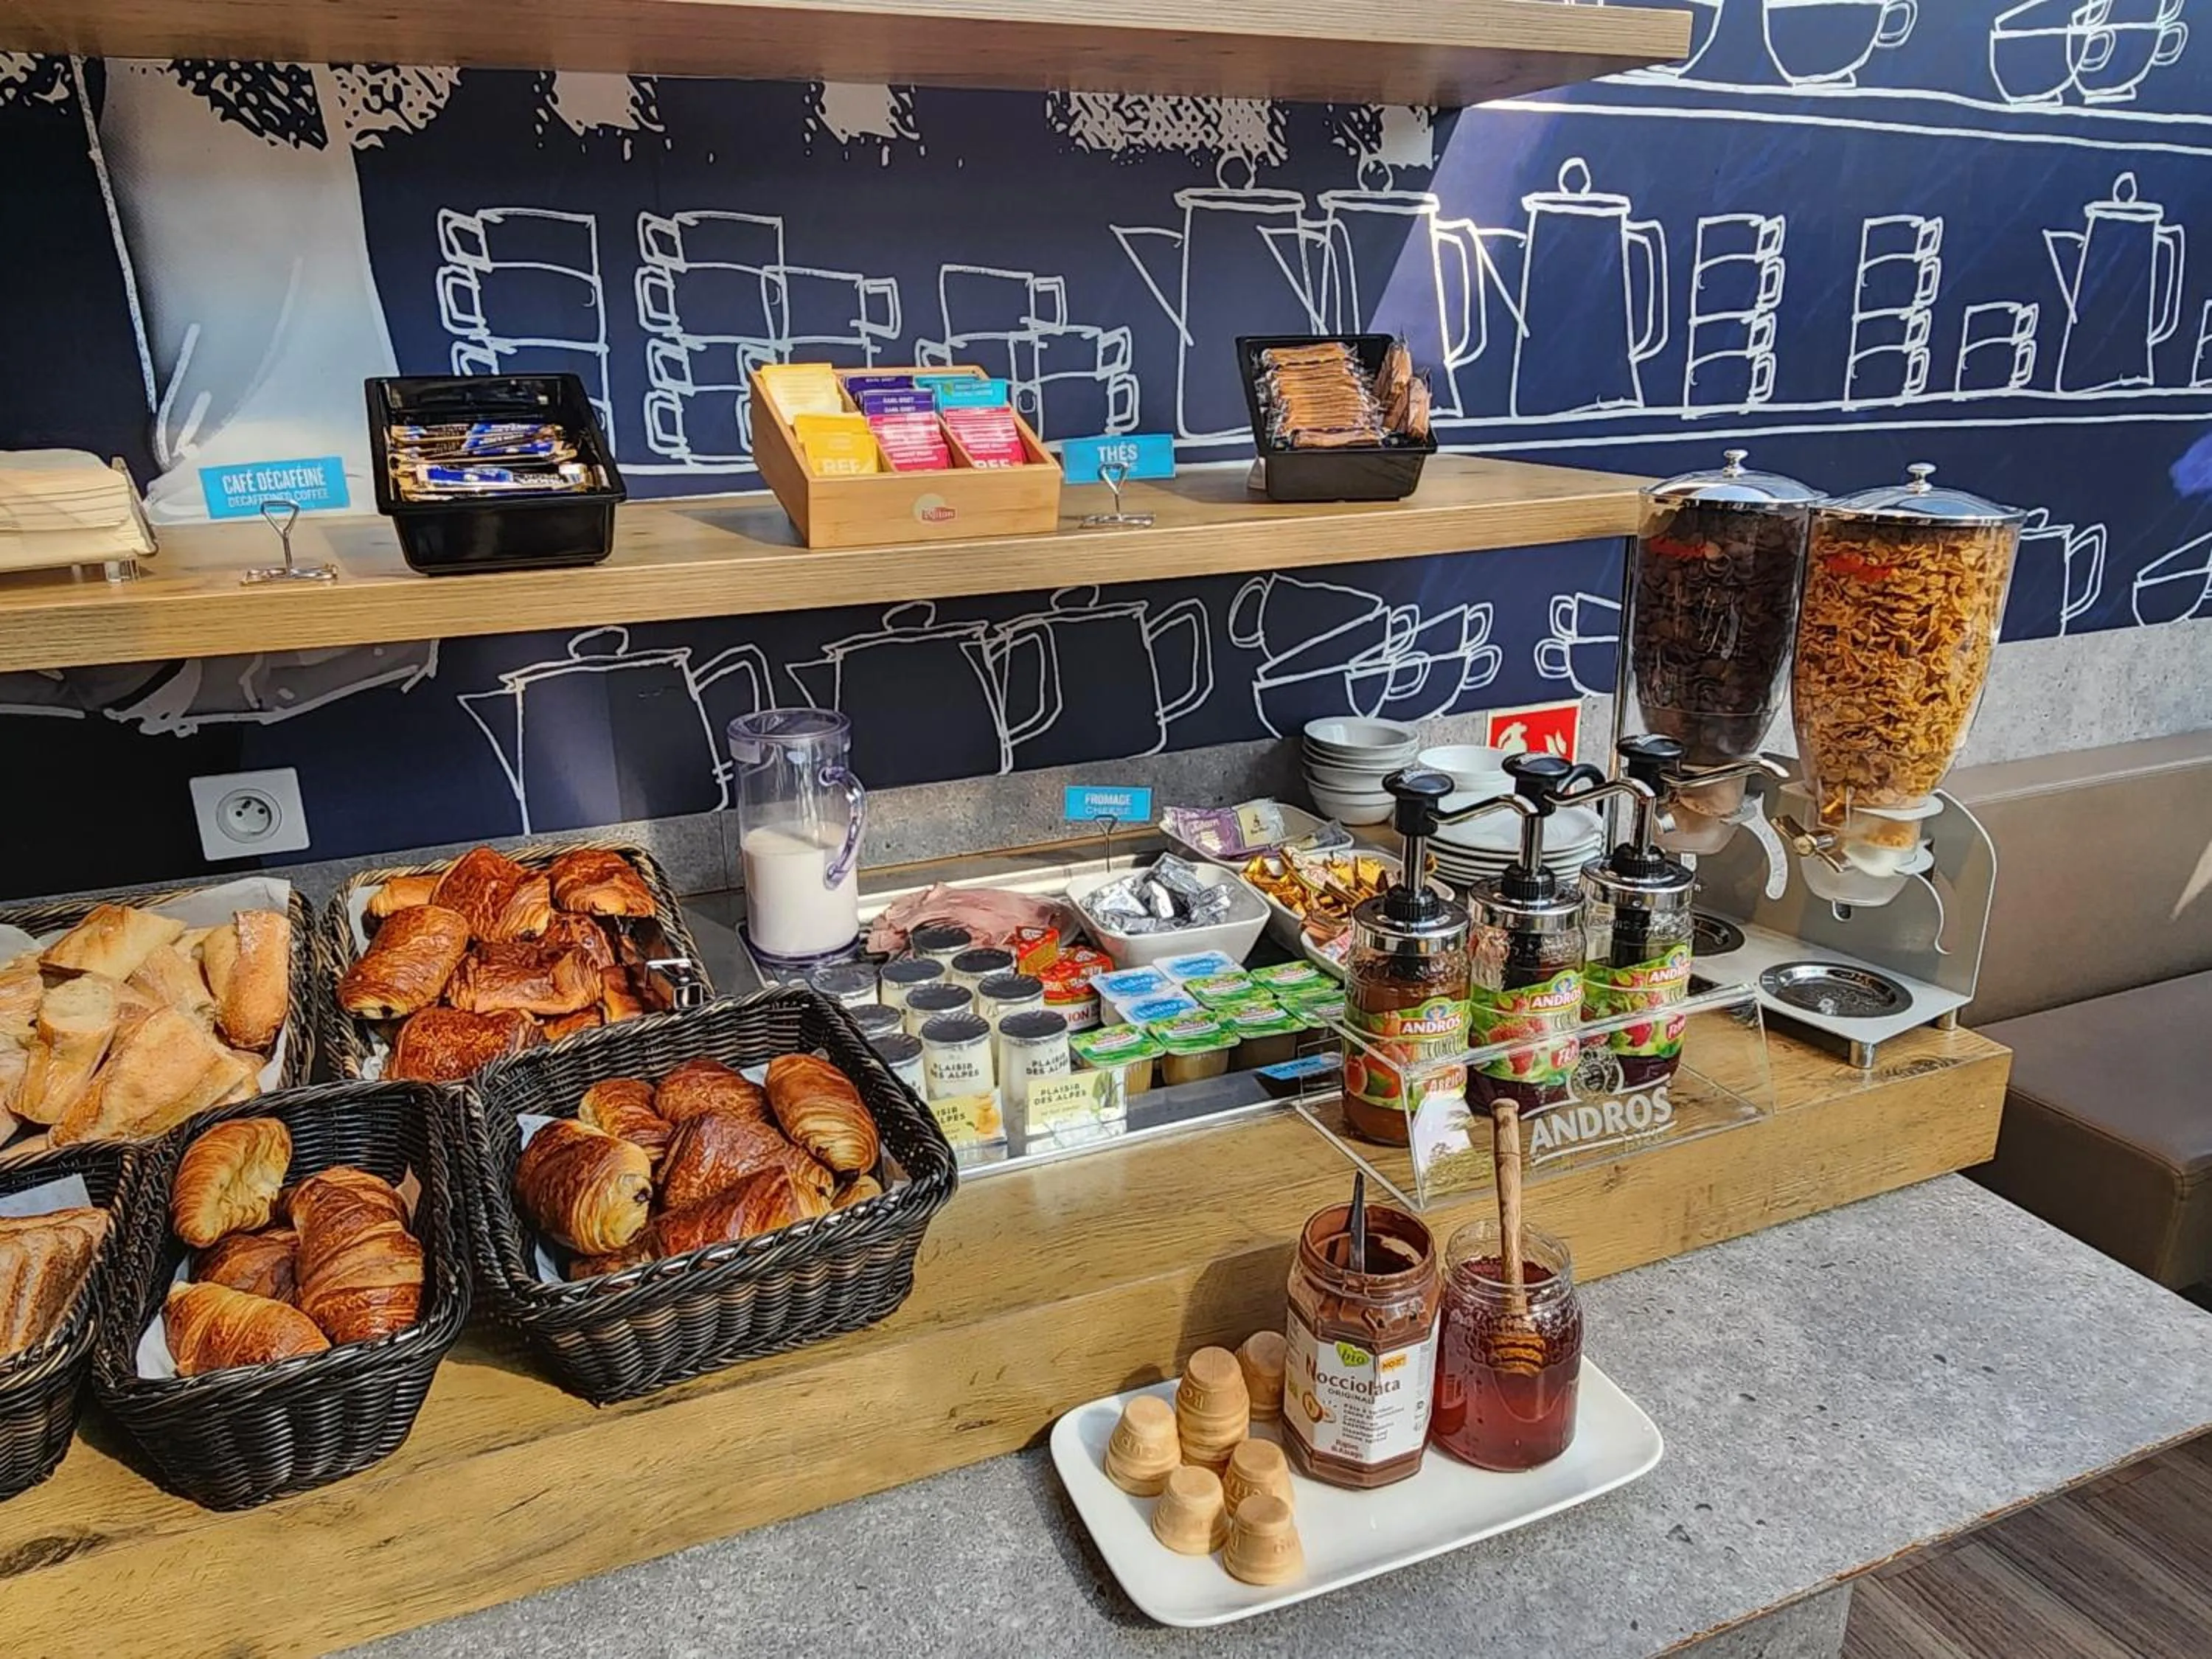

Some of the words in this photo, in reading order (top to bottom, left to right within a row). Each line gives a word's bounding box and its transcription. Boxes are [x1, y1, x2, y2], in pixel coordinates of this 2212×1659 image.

[1097, 441, 1138, 463] THÉS
[223, 469, 257, 494] CAFÉ
[257, 462, 327, 490] DÉCAFÉINÉ
[1085, 793, 1133, 806] FROMAGE
[1402, 1015, 1462, 1034] ANDROS
[1034, 1096, 1052, 1105] DES
[1055, 1089, 1086, 1101] ALPES
[1040, 1082, 1080, 1096] PLAISIR
[1529, 1085, 1673, 1155] ANDROS
[1340, 1349, 1365, 1364] bio
[1306, 1353, 1401, 1396] Nocciolata
